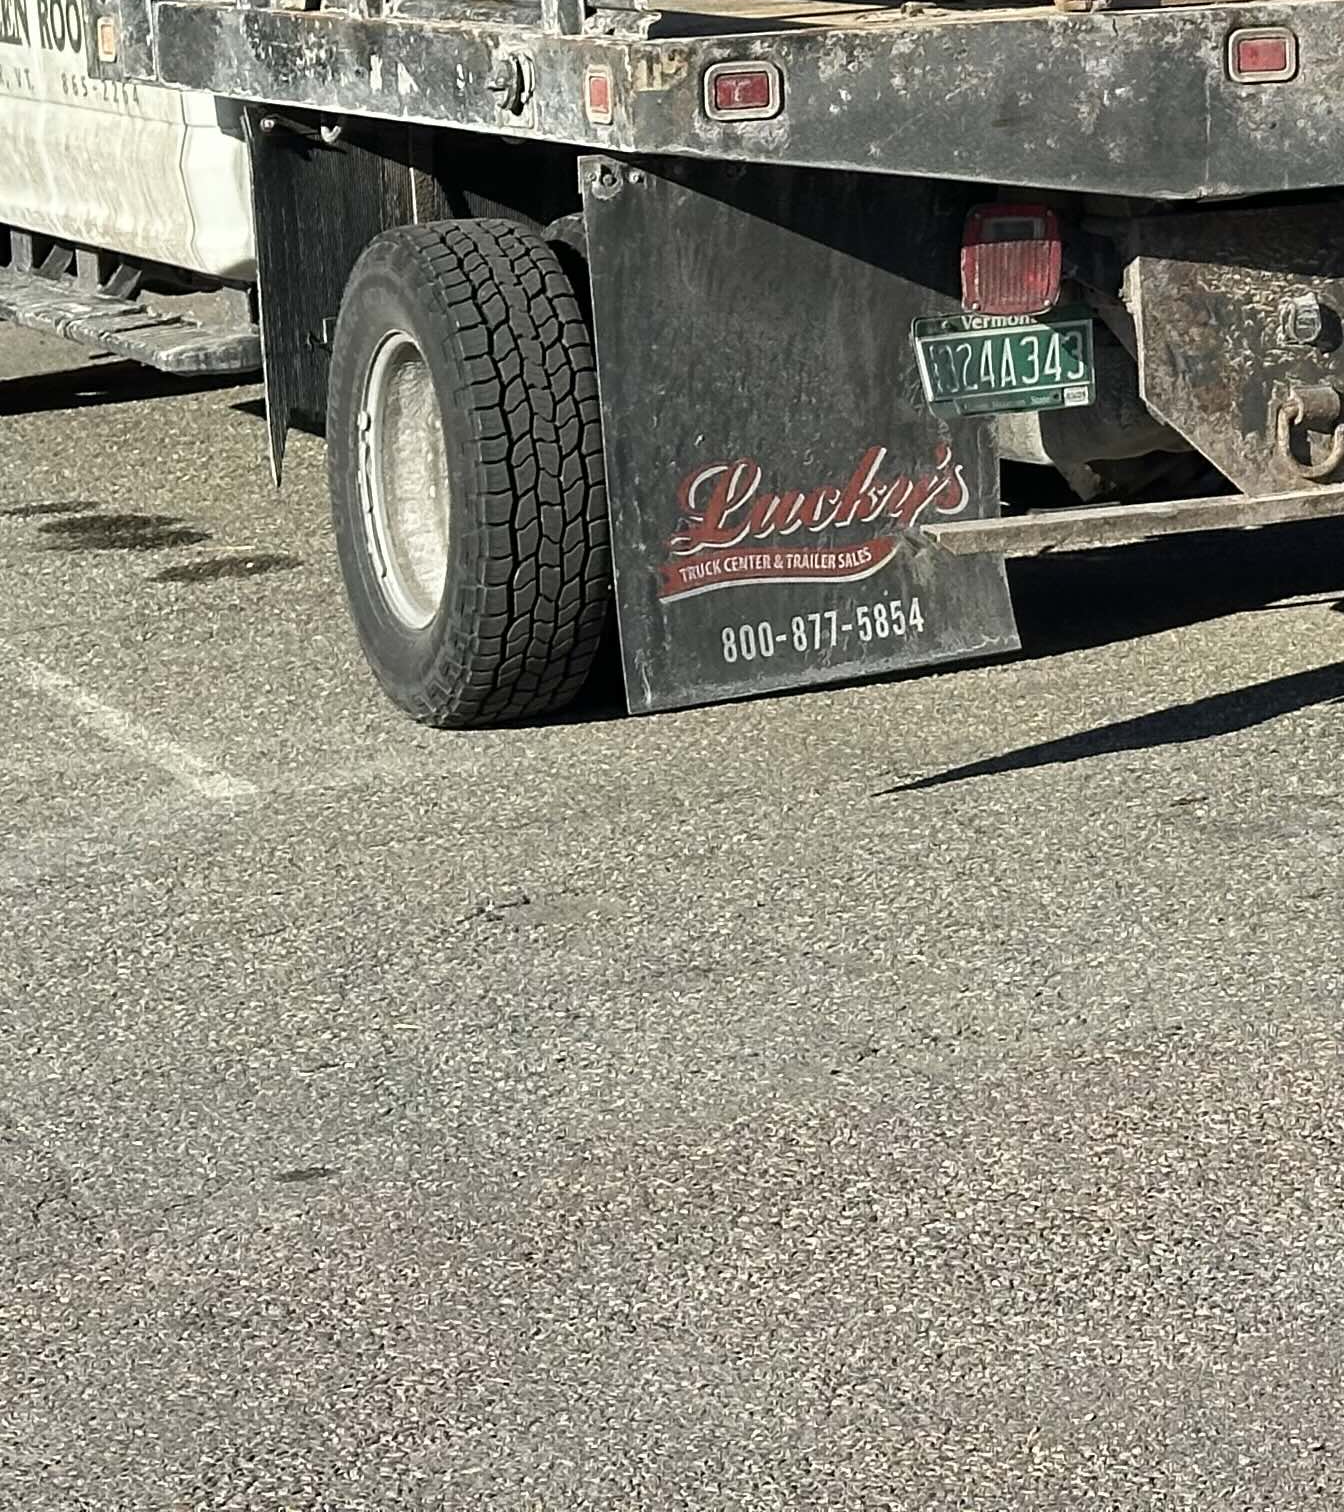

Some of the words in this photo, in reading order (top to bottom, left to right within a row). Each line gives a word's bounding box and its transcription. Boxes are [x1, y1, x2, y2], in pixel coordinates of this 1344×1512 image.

[667, 441, 970, 556] Lucky's
[678, 560, 721, 582] TRUCK
[723, 553, 772, 571] CENTER
[773, 554, 784, 569] &
[785, 552, 836, 569] TRAILER
[837, 546, 873, 569] SALES
[720, 596, 926, 663] 800-877-5854
